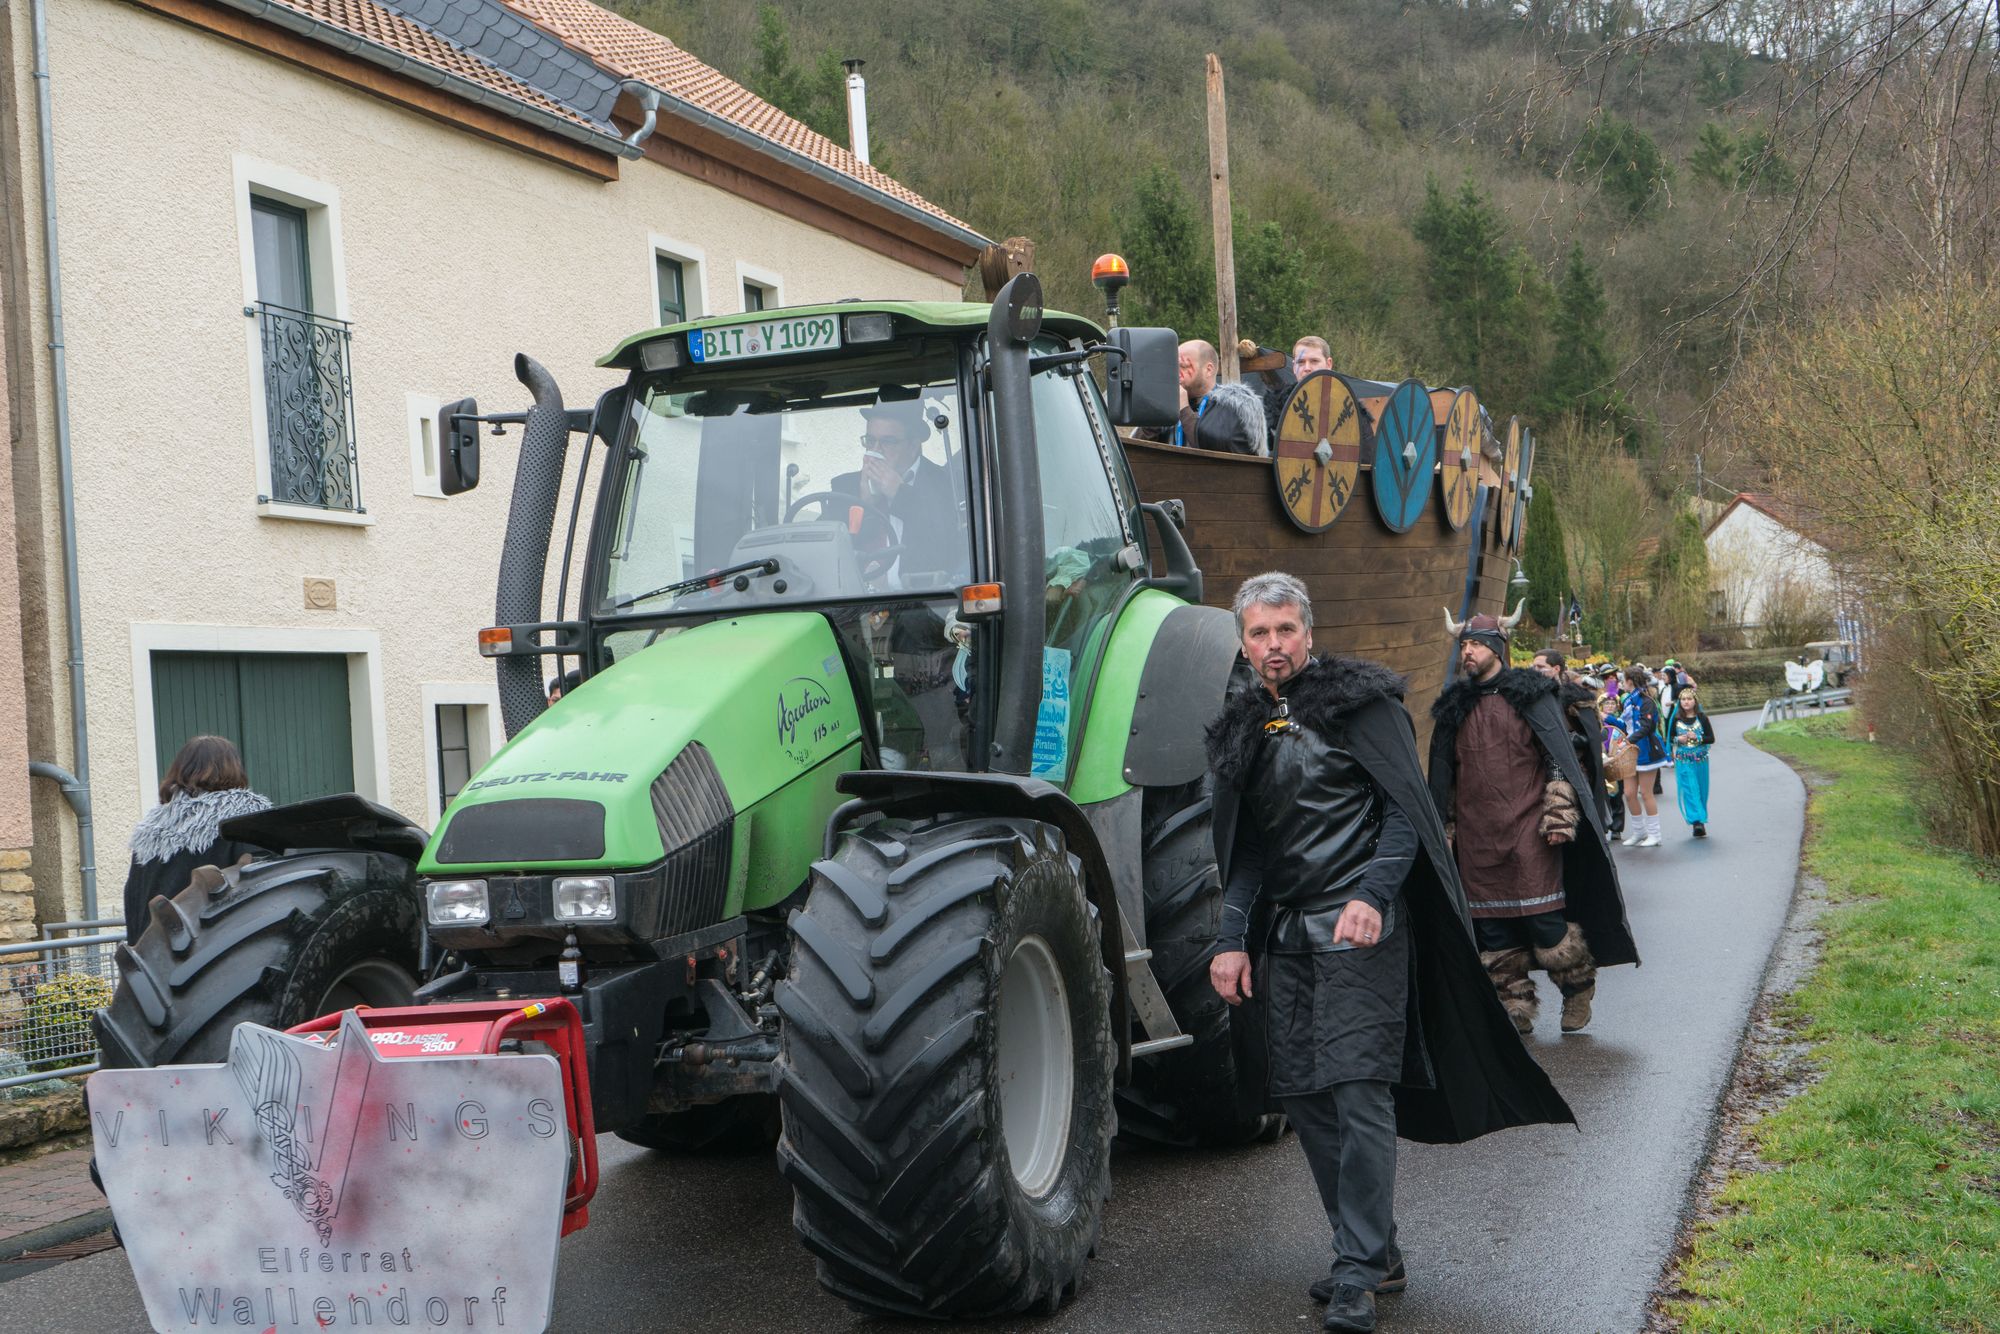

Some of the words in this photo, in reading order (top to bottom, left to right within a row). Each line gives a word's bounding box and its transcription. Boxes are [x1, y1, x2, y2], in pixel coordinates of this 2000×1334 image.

[703, 328, 744, 358] BIT
[761, 324, 774, 351] Y
[780, 318, 835, 349] 1099
[813, 723, 828, 742] 115
[1035, 738, 1057, 751] Piraten
[467, 771, 629, 792] DEUTZ-FAHR
[420, 1041, 457, 1053] 3500
[95, 1098, 557, 1148] VIKINGS
[258, 1246, 413, 1274] Elferrat
[179, 1286, 508, 1327] Wallendorf
